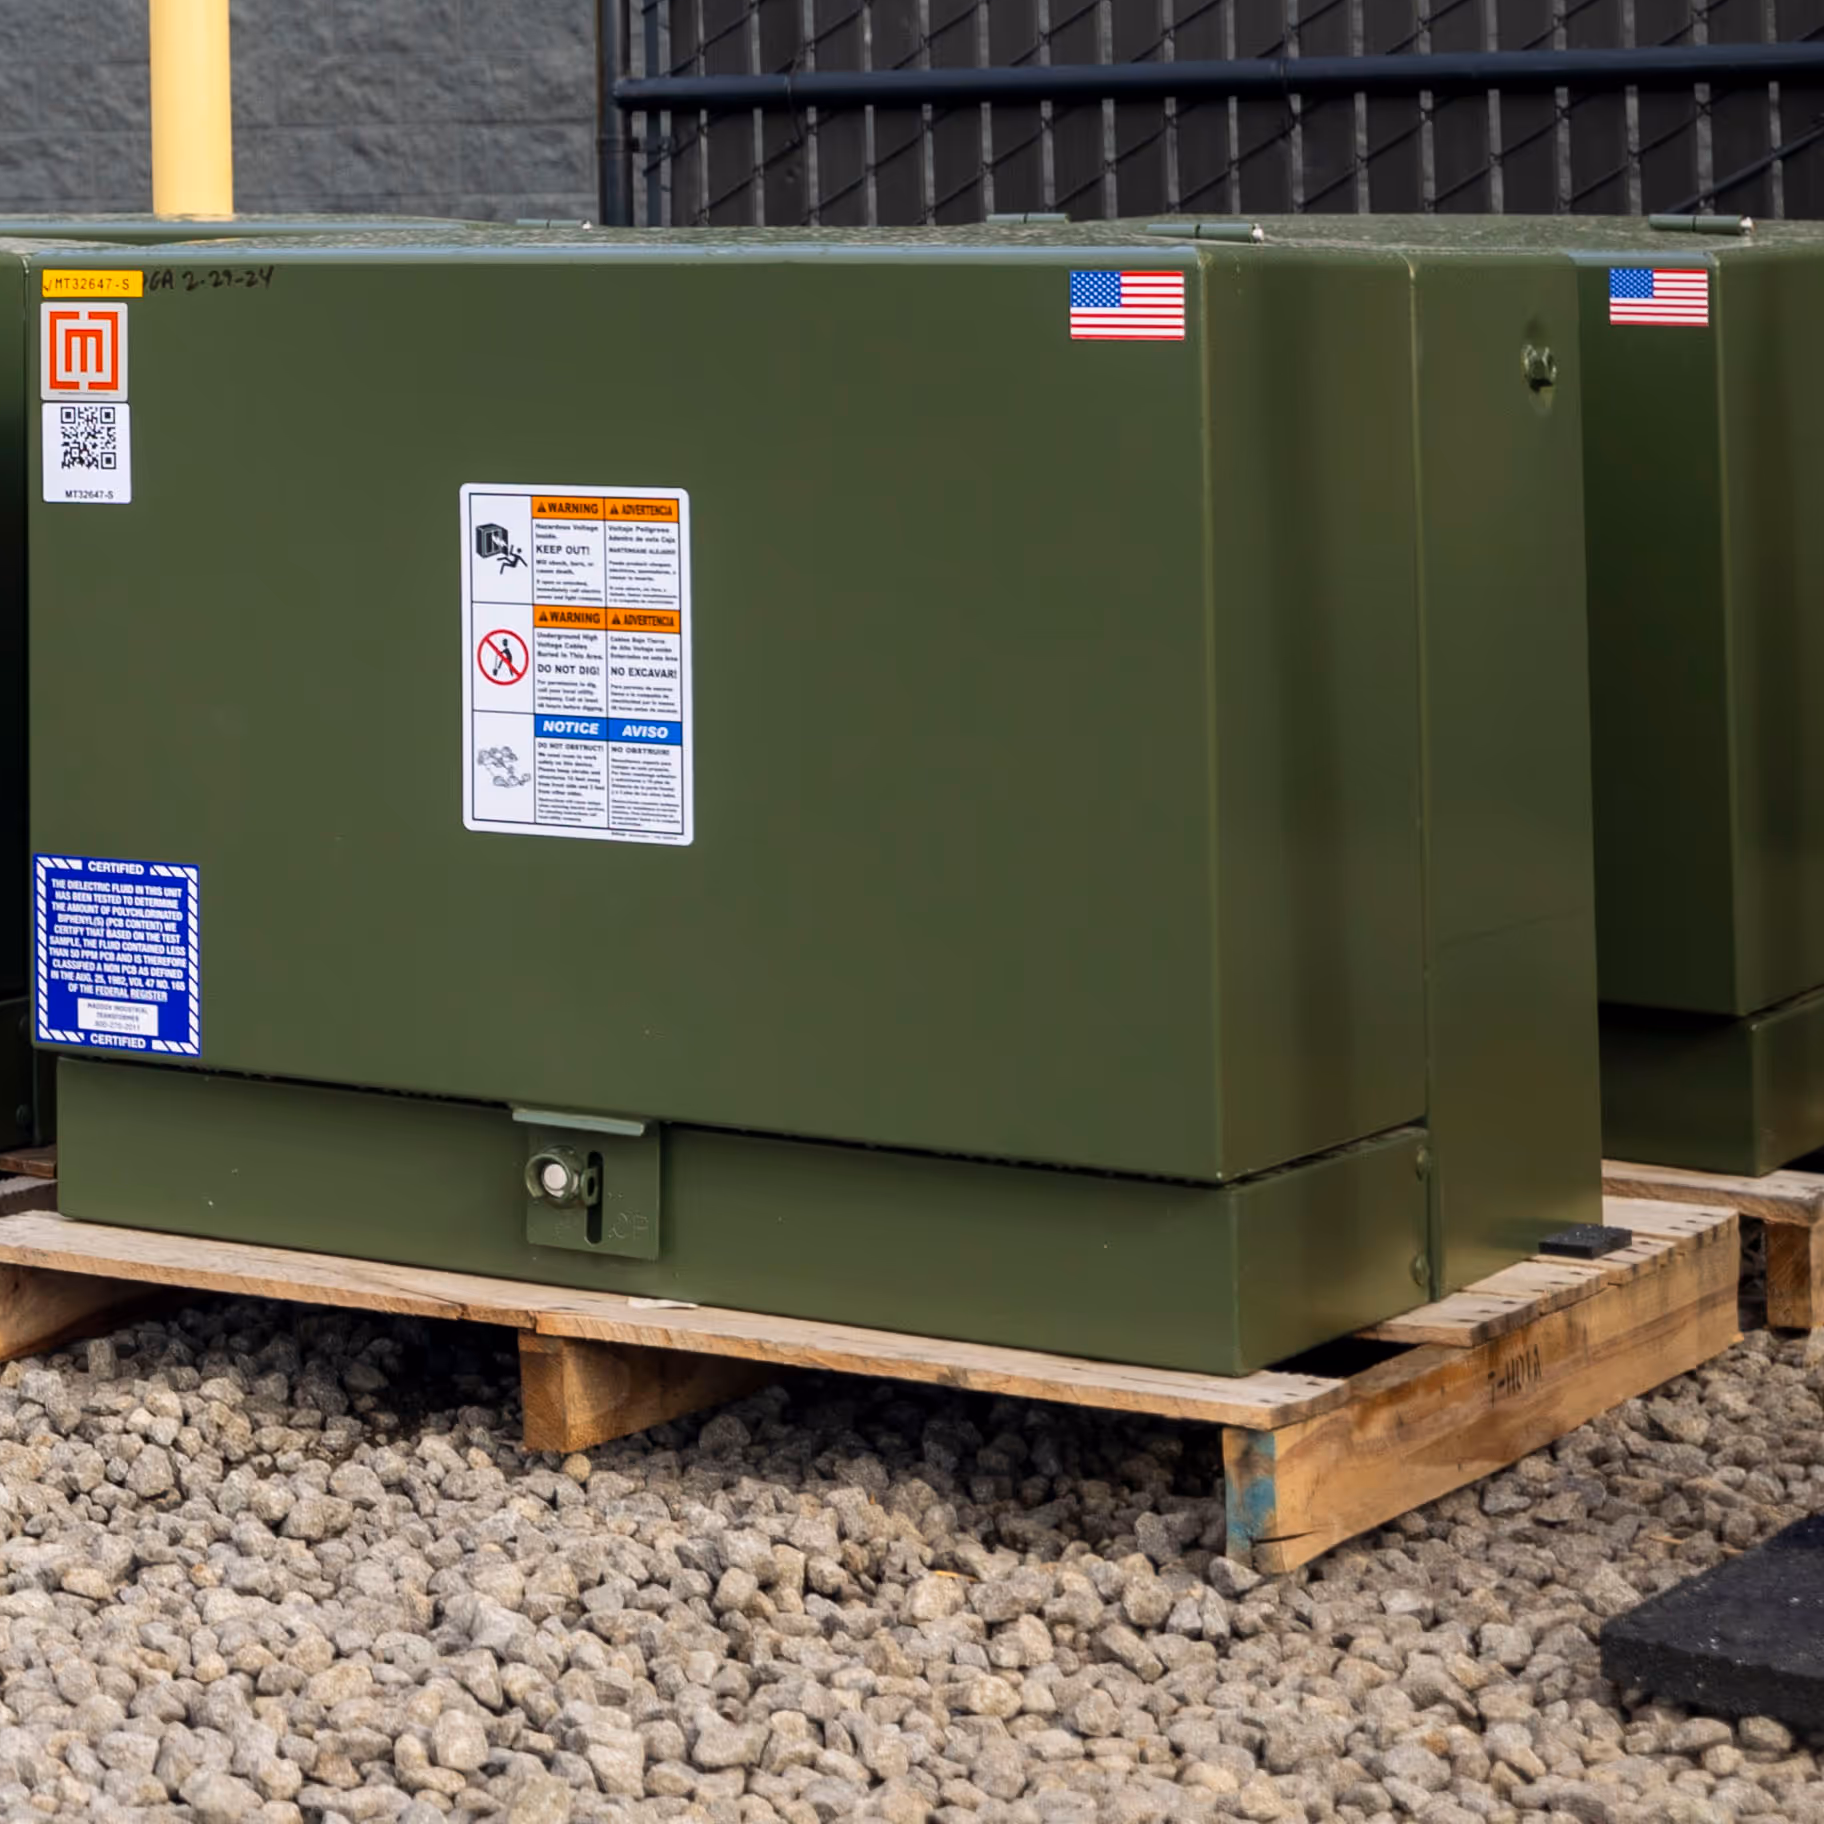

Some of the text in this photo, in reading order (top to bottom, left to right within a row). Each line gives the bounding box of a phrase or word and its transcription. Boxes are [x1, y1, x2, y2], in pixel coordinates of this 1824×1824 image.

[54, 278, 130, 290] MT32647-S
[65, 490, 114, 500] MT32647-S
[548, 502, 599, 514] WARNING
[621, 504, 673, 516] ADVERTENCIA
[536, 544, 590, 555] KEEP OUT!
[549, 611, 600, 624] WARNING
[623, 614, 674, 627] ADVERTENCIA
[537, 663, 600, 676] DO NOT DIG!
[611, 666, 677, 679] NO EXCAVAR!
[543, 720, 599, 735] NOTICE
[622, 724, 668, 739] AVISO
[549, 742, 563, 750] NOT
[88, 861, 144, 875] CERTIFIED
[91, 1033, 146, 1049] CERTIFIED
